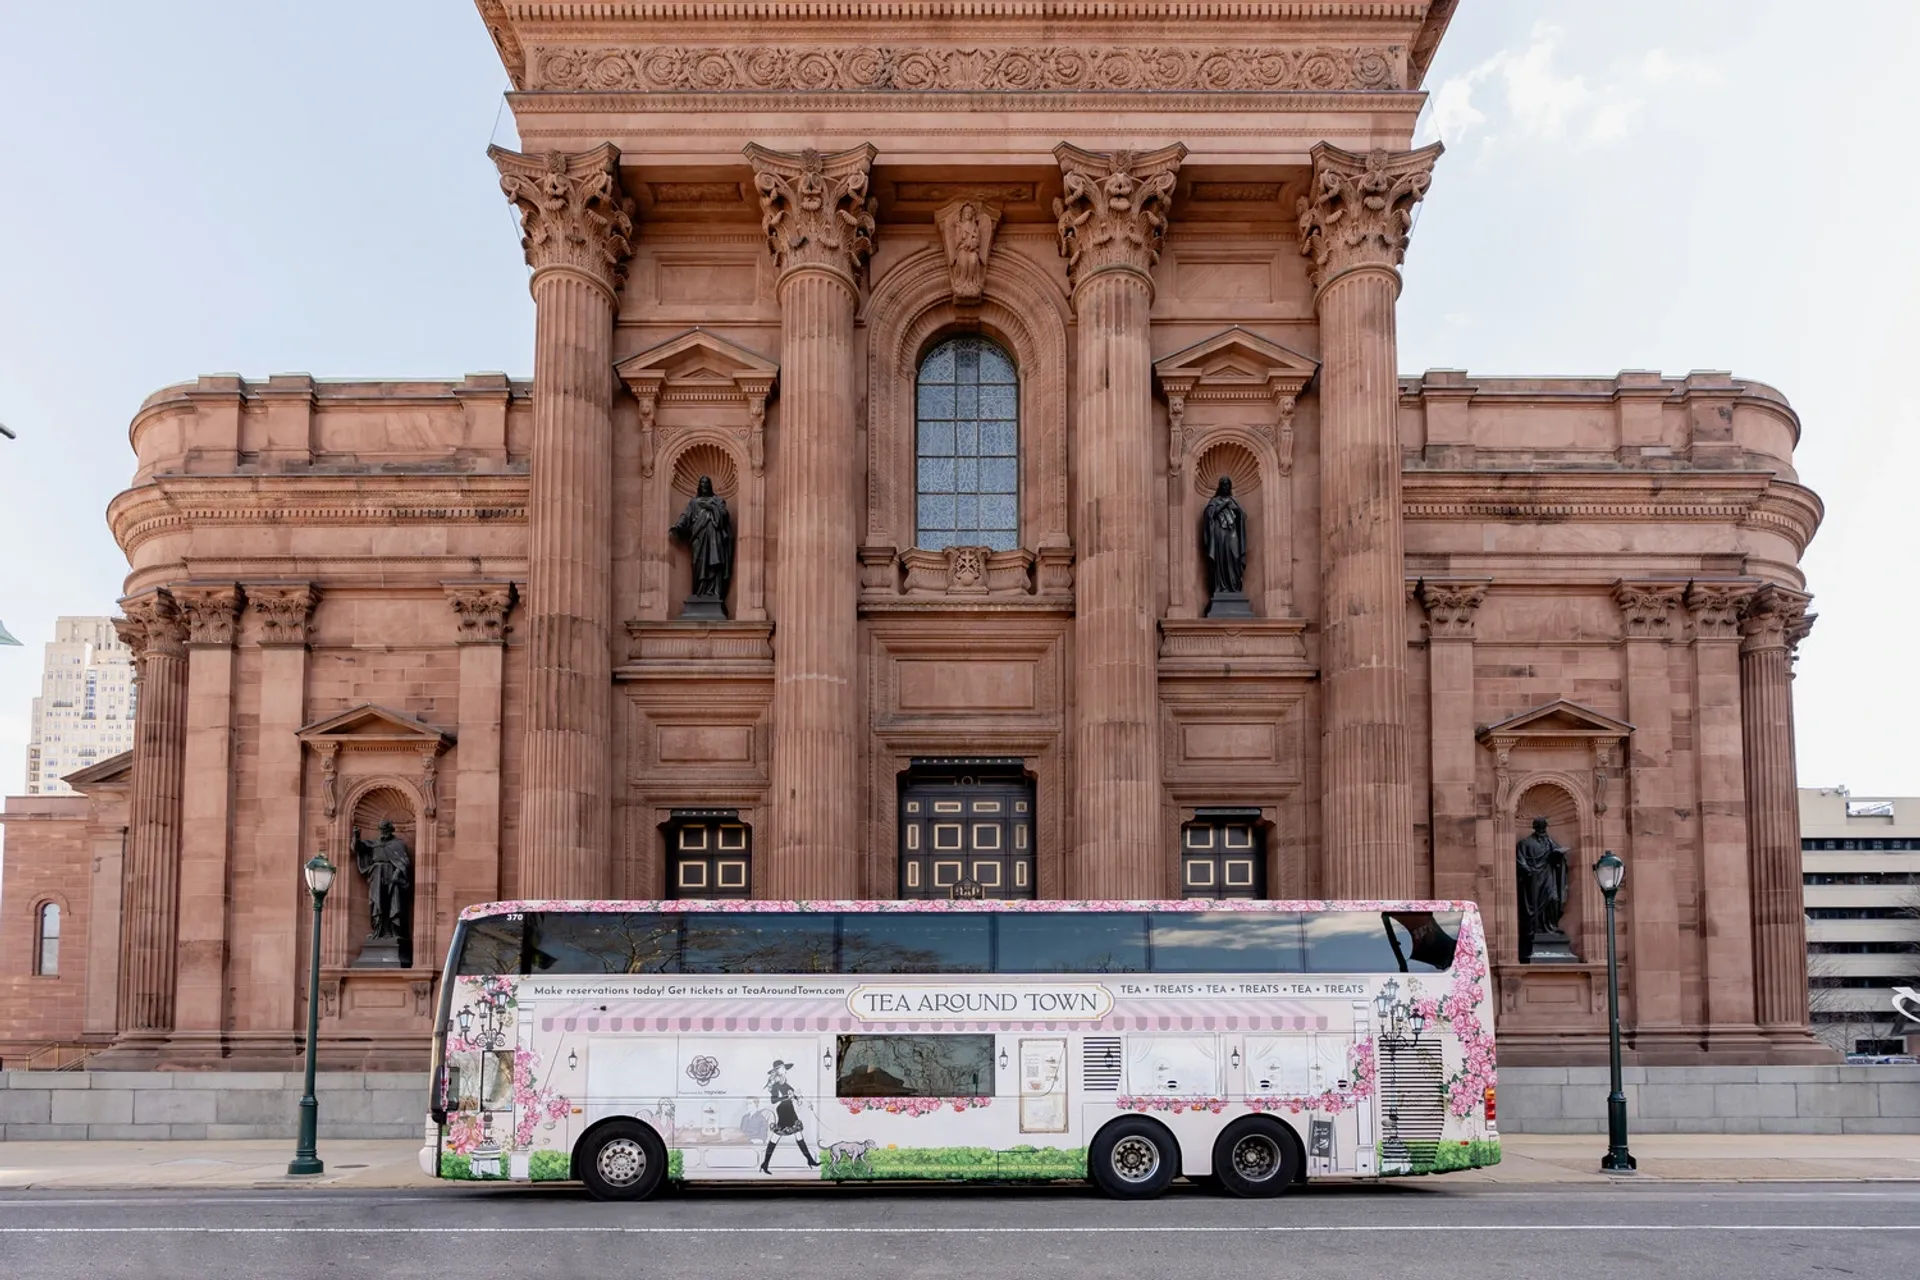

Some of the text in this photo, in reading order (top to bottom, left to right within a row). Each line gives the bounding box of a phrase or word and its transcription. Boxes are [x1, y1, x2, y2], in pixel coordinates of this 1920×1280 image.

[506, 913, 524, 921] 370
[534, 985, 845, 997] Make reservations today! Get tickets at TeaAroundTown.com
[1120, 984, 1364, 994] TEA TREATS TEA TREATS TEA TREATS
[863, 993, 1097, 1013] TEA AROUND TOWN
